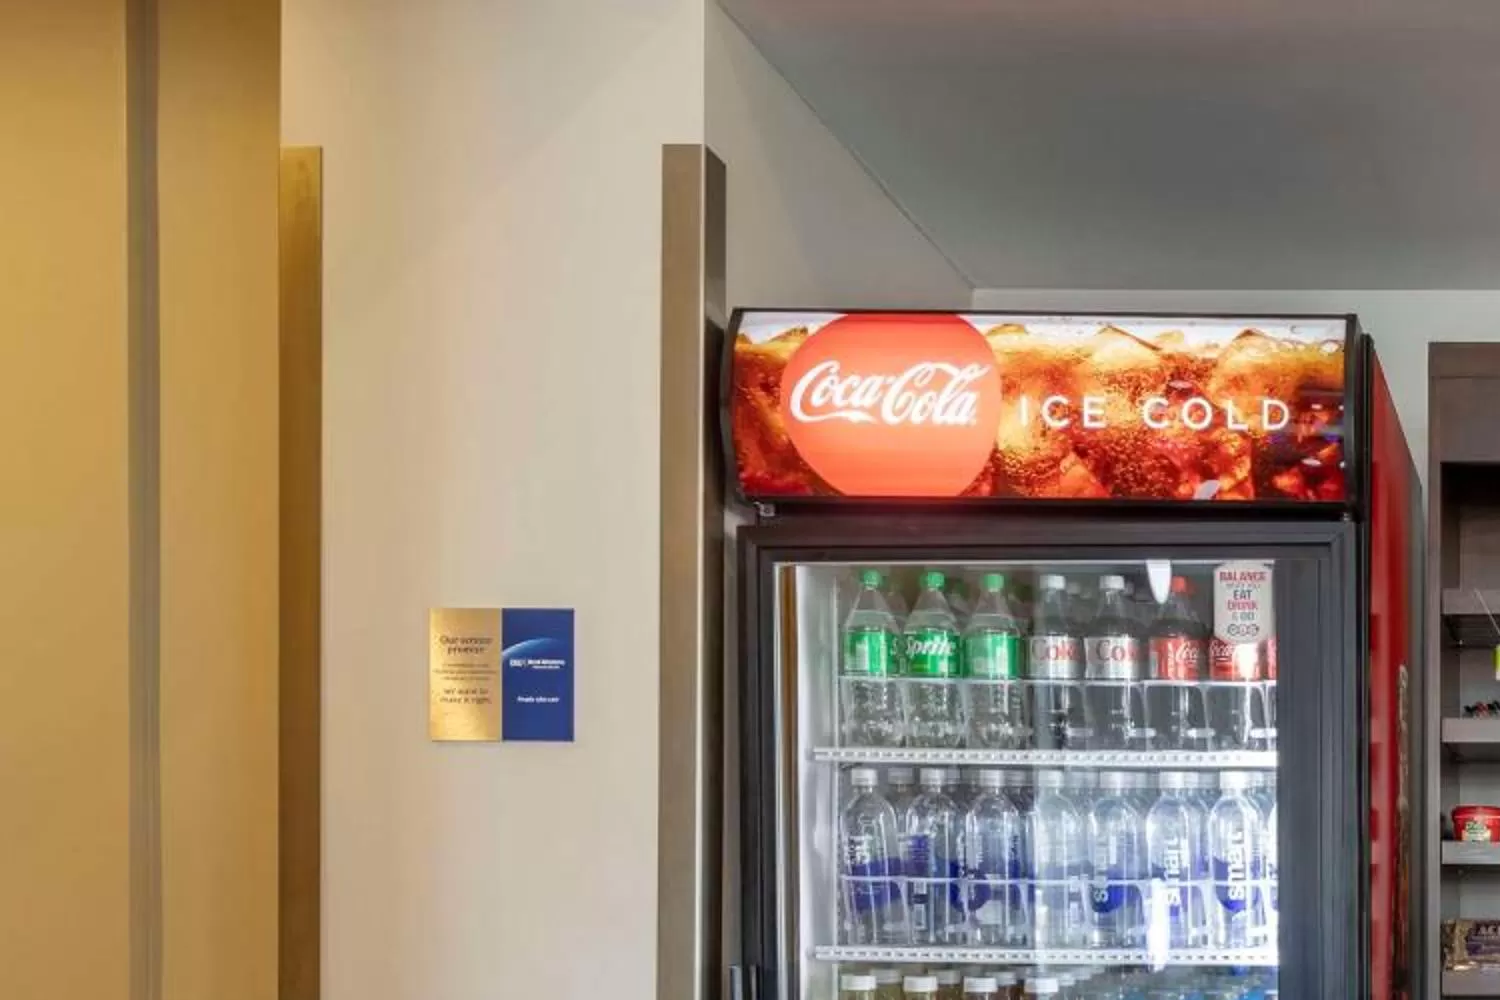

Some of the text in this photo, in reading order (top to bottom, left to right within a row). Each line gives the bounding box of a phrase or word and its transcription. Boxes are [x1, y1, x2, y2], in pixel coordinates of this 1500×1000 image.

[789, 360, 991, 426] Coca-Cola
[1019, 395, 1290, 432] ICE COLD
[1233, 589, 1253, 600] EAT
